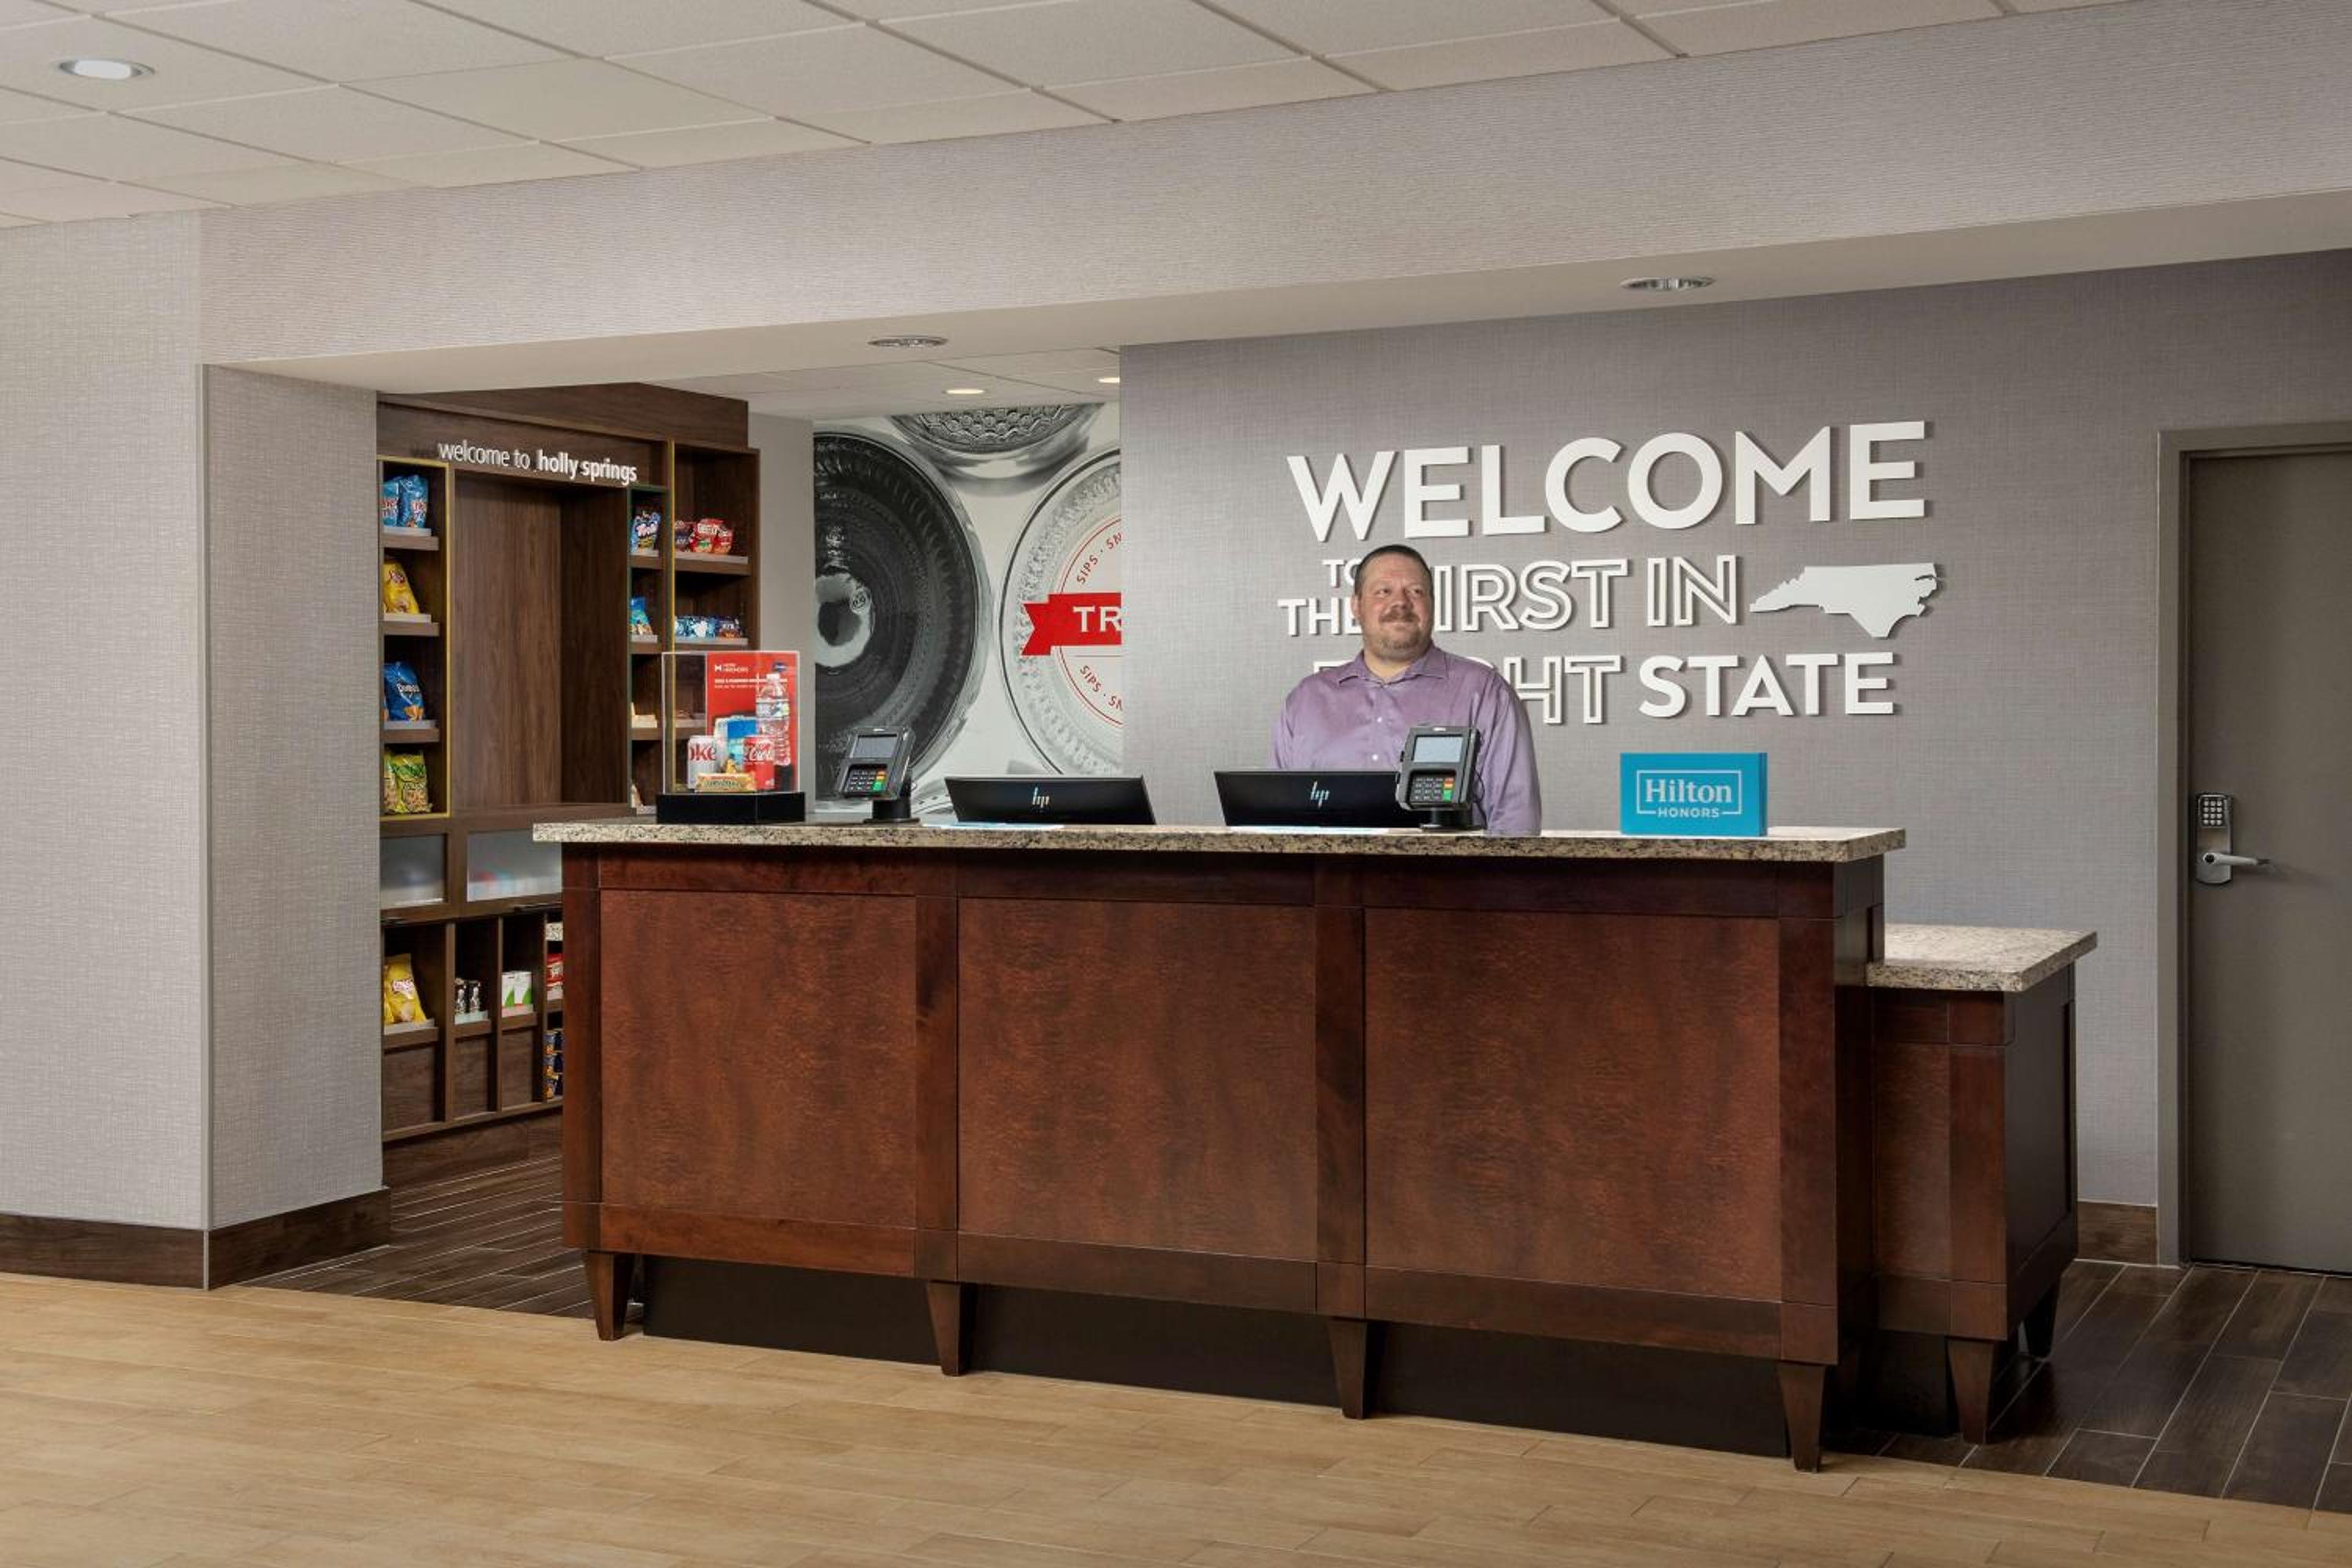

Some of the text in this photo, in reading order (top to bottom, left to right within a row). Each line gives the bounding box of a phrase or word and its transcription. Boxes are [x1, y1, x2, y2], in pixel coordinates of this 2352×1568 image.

[437, 440, 637, 486] welcome to holly springs
[1287, 421, 1926, 543] WELCOME
[1076, 554, 1098, 585] SIPS
[1433, 554, 1737, 631] IRST IN
[1080, 665, 1102, 692] SIPS
[1639, 652, 1894, 717] STATE
[1310, 781, 1330, 809] hp
[1646, 779, 1733, 803] Hilton
[1657, 807, 1720, 818] HONORS
